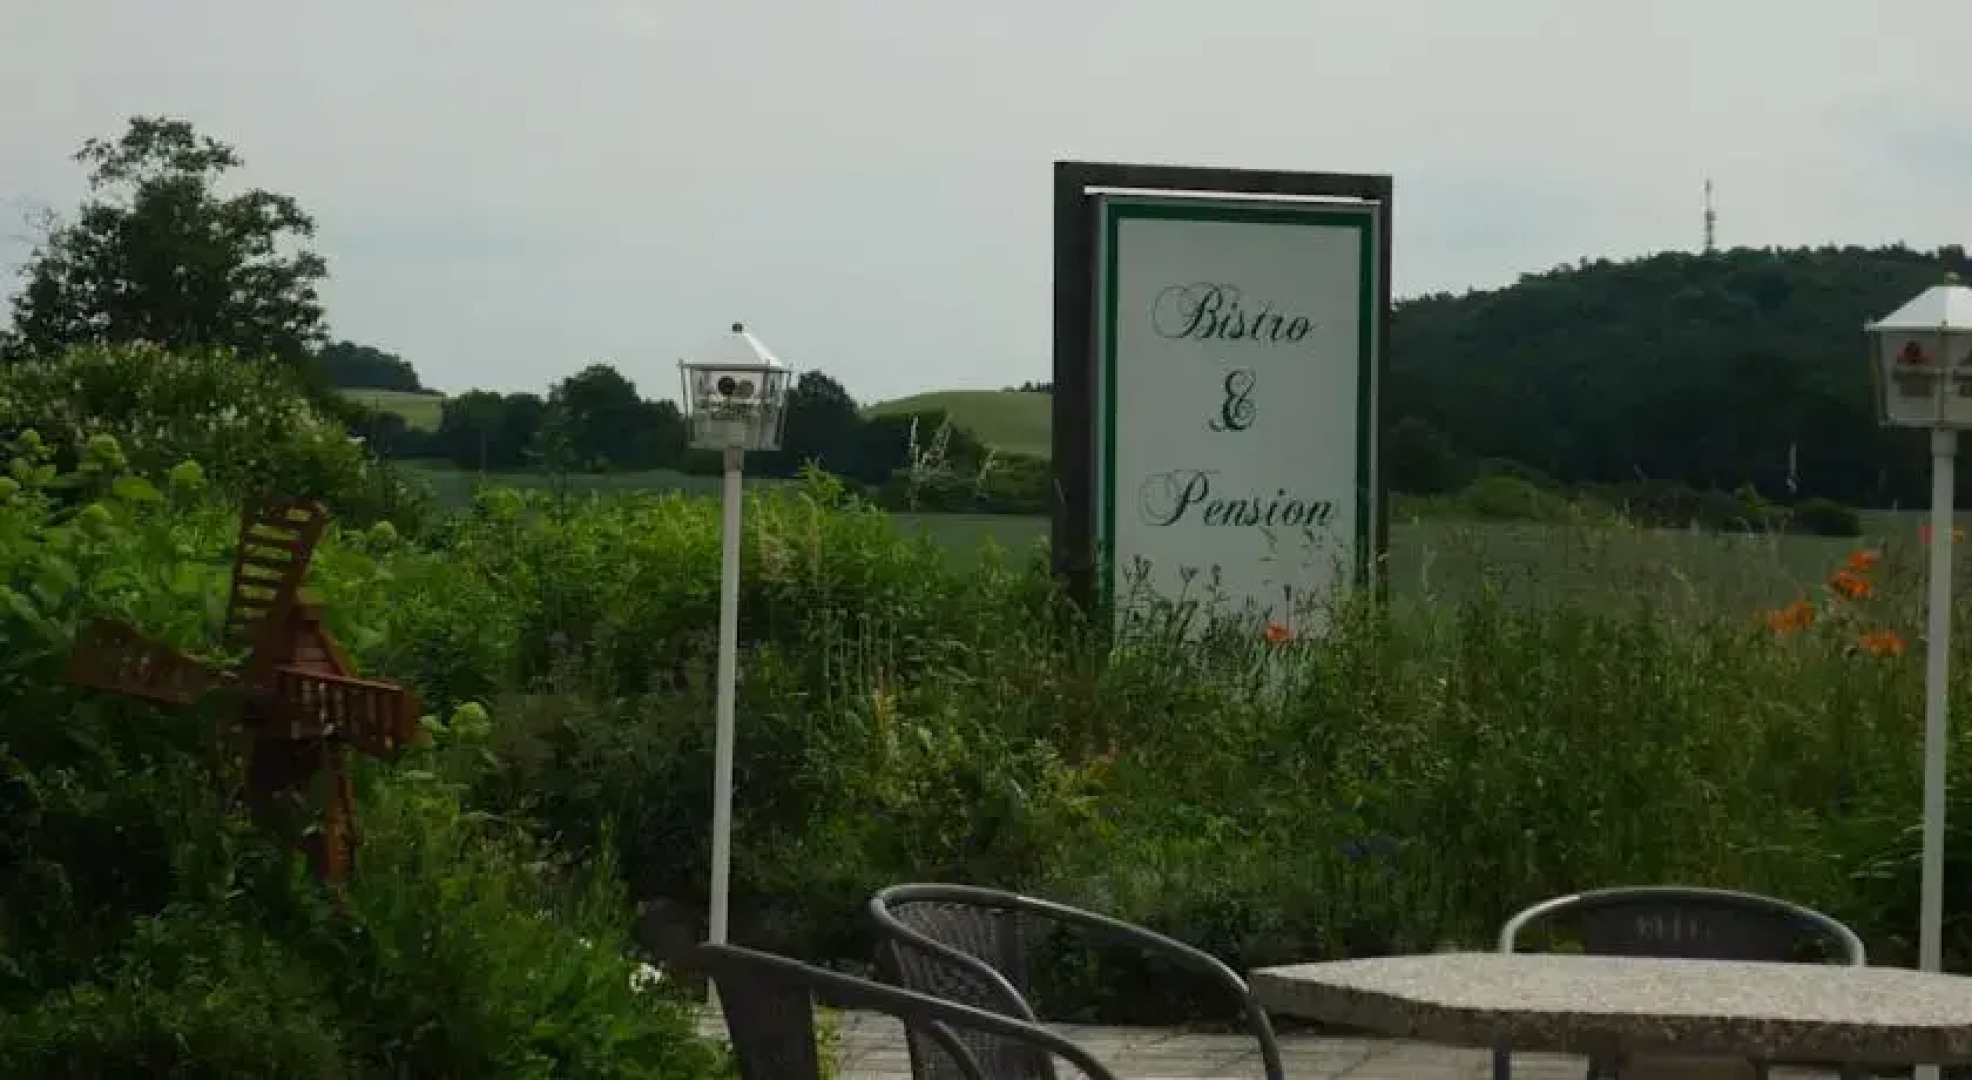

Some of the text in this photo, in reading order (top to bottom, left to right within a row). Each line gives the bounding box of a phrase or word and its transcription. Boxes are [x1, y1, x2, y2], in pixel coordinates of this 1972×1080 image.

[1152, 281, 1315, 340] Bistro
[1207, 368, 1257, 432] &
[1139, 469, 1335, 527] Pension
